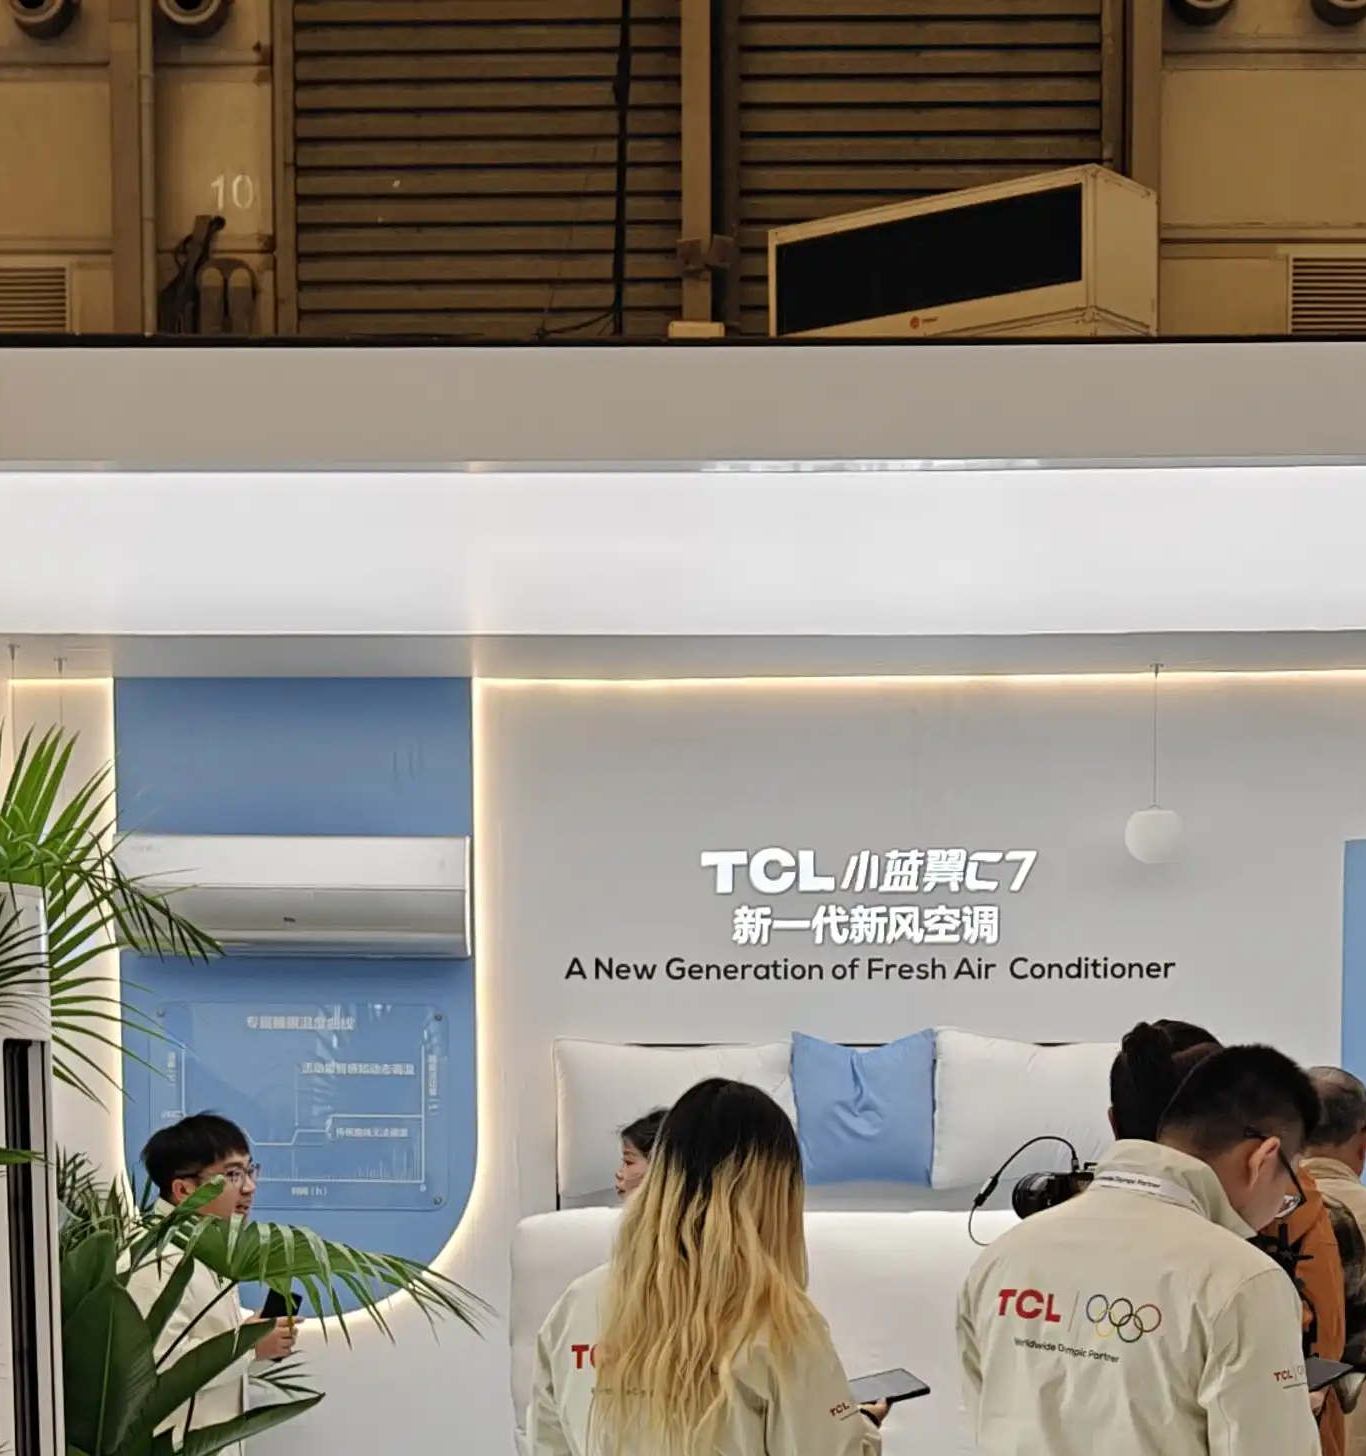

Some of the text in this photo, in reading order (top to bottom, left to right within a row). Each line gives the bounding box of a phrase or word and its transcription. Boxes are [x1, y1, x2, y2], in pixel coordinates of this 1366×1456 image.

[211, 174, 253, 211] 10
[700, 847, 1038, 894] TCL 小蓝翼C7
[732, 905, 999, 945] 新一代新风空调
[565, 957, 1176, 980] A New Generation of Fresh Air Conditioner
[998, 1288, 1062, 1322] TCL
[1088, 1349, 1120, 1363] Partner
[1273, 1369, 1293, 1381] TCL
[829, 1402, 851, 1417] TCL
